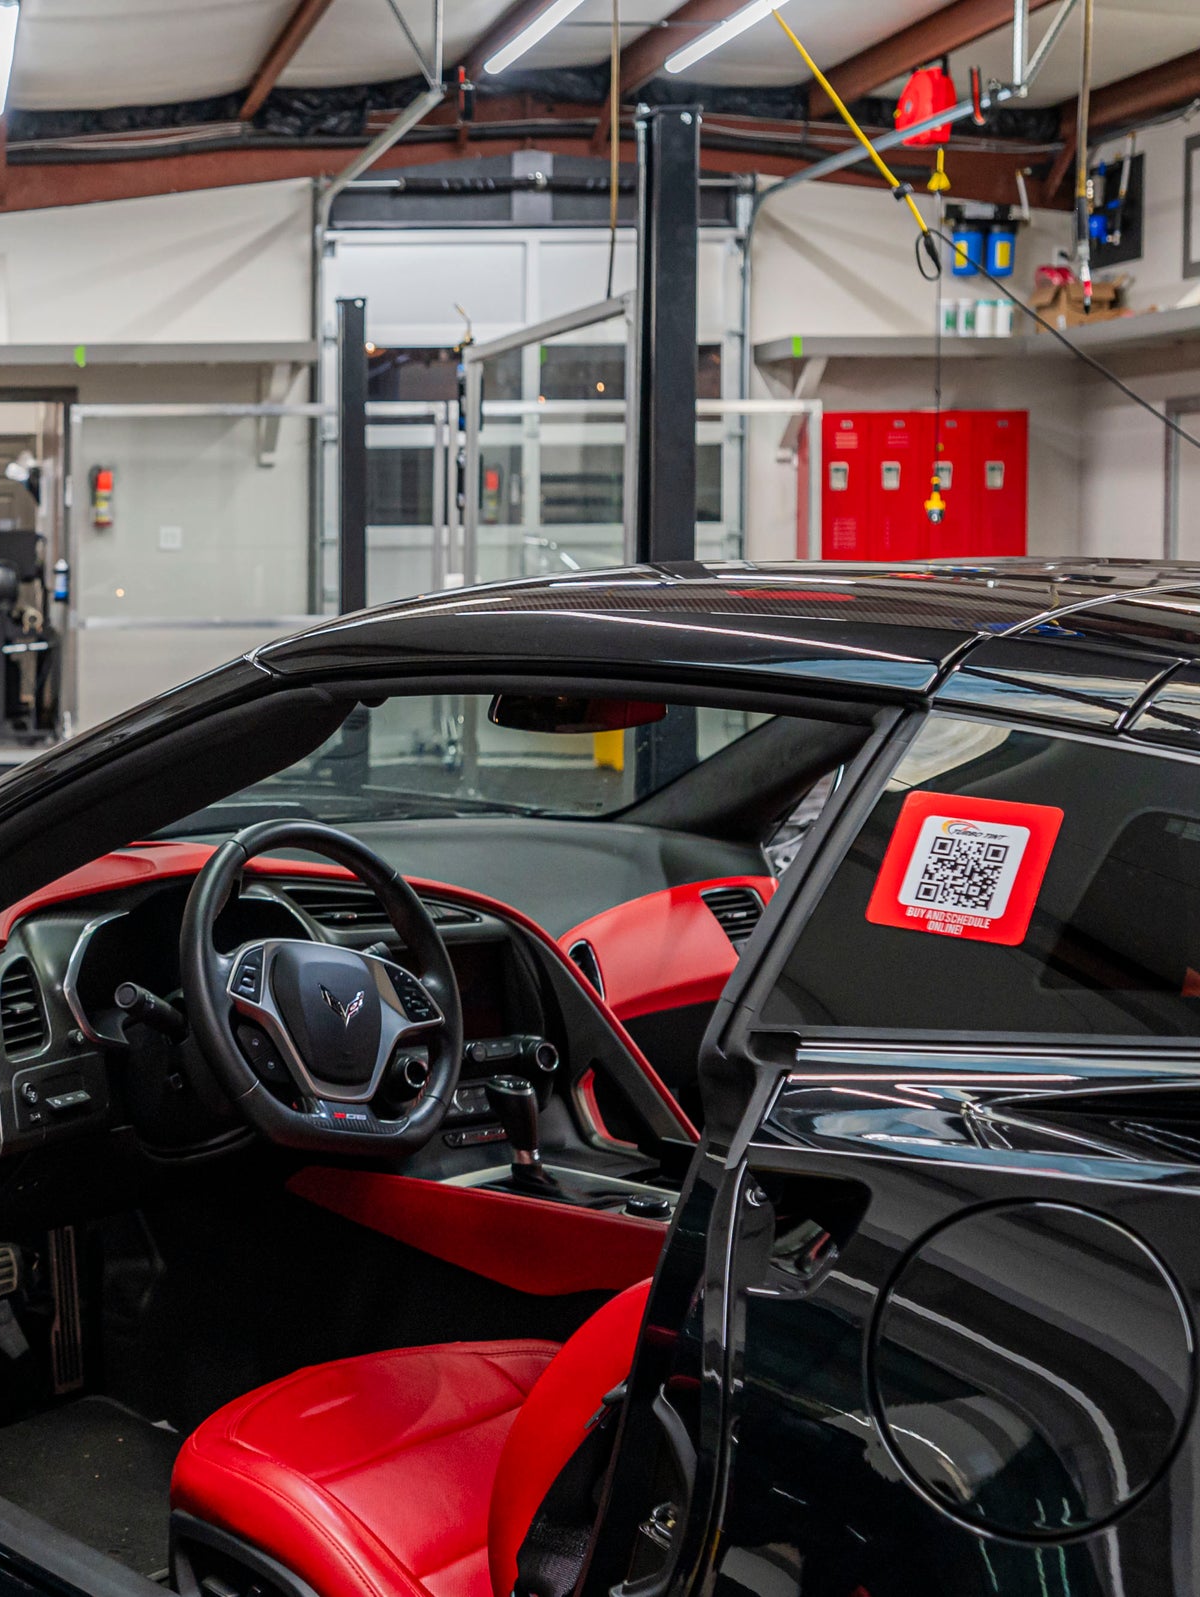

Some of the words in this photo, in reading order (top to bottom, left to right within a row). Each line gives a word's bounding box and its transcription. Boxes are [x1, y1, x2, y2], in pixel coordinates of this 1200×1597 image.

[906, 907, 926, 918] BUY
[926, 910, 945, 921] AND
[945, 913, 991, 928] SCHEDULE
[927, 921, 963, 934] ONLINE!
